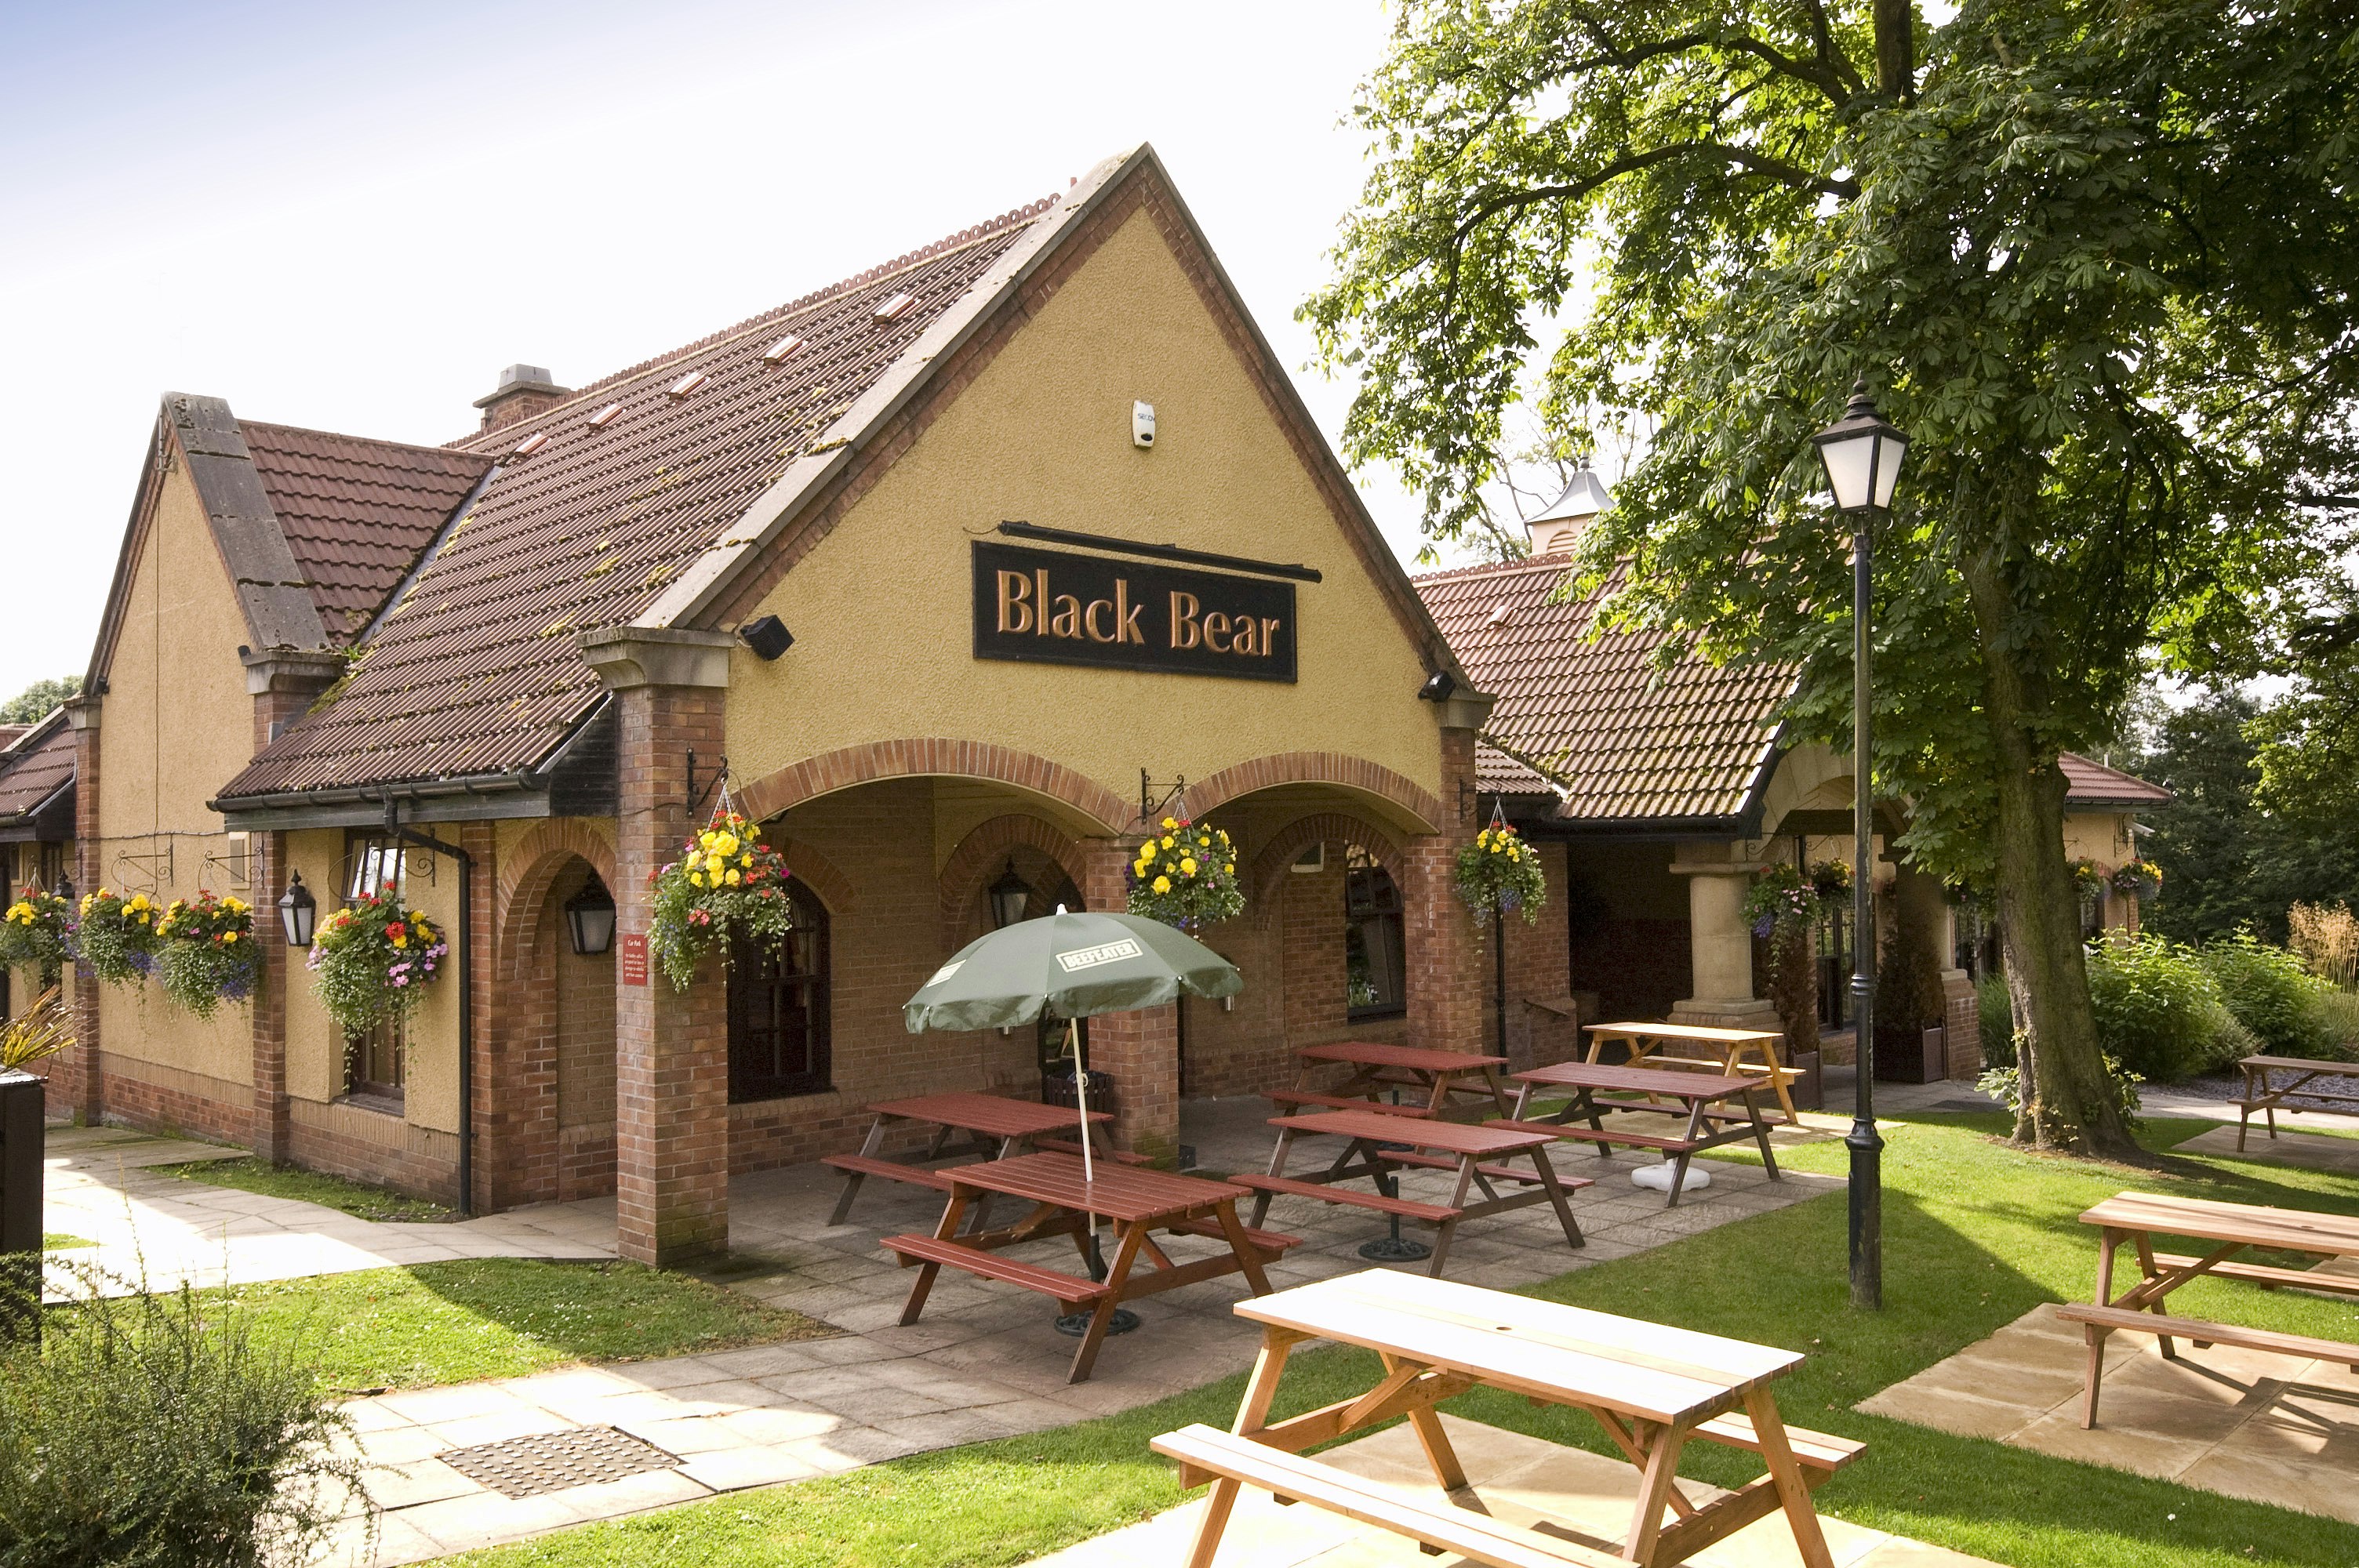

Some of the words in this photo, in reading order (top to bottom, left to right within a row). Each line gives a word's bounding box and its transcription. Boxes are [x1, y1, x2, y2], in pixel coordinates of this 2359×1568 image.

[1137, 413, 1155, 422] SECO
[997, 568, 1145, 646] Black
[1169, 590, 1280, 658] Bear
[1063, 942, 1136, 968] BEEFEATER
